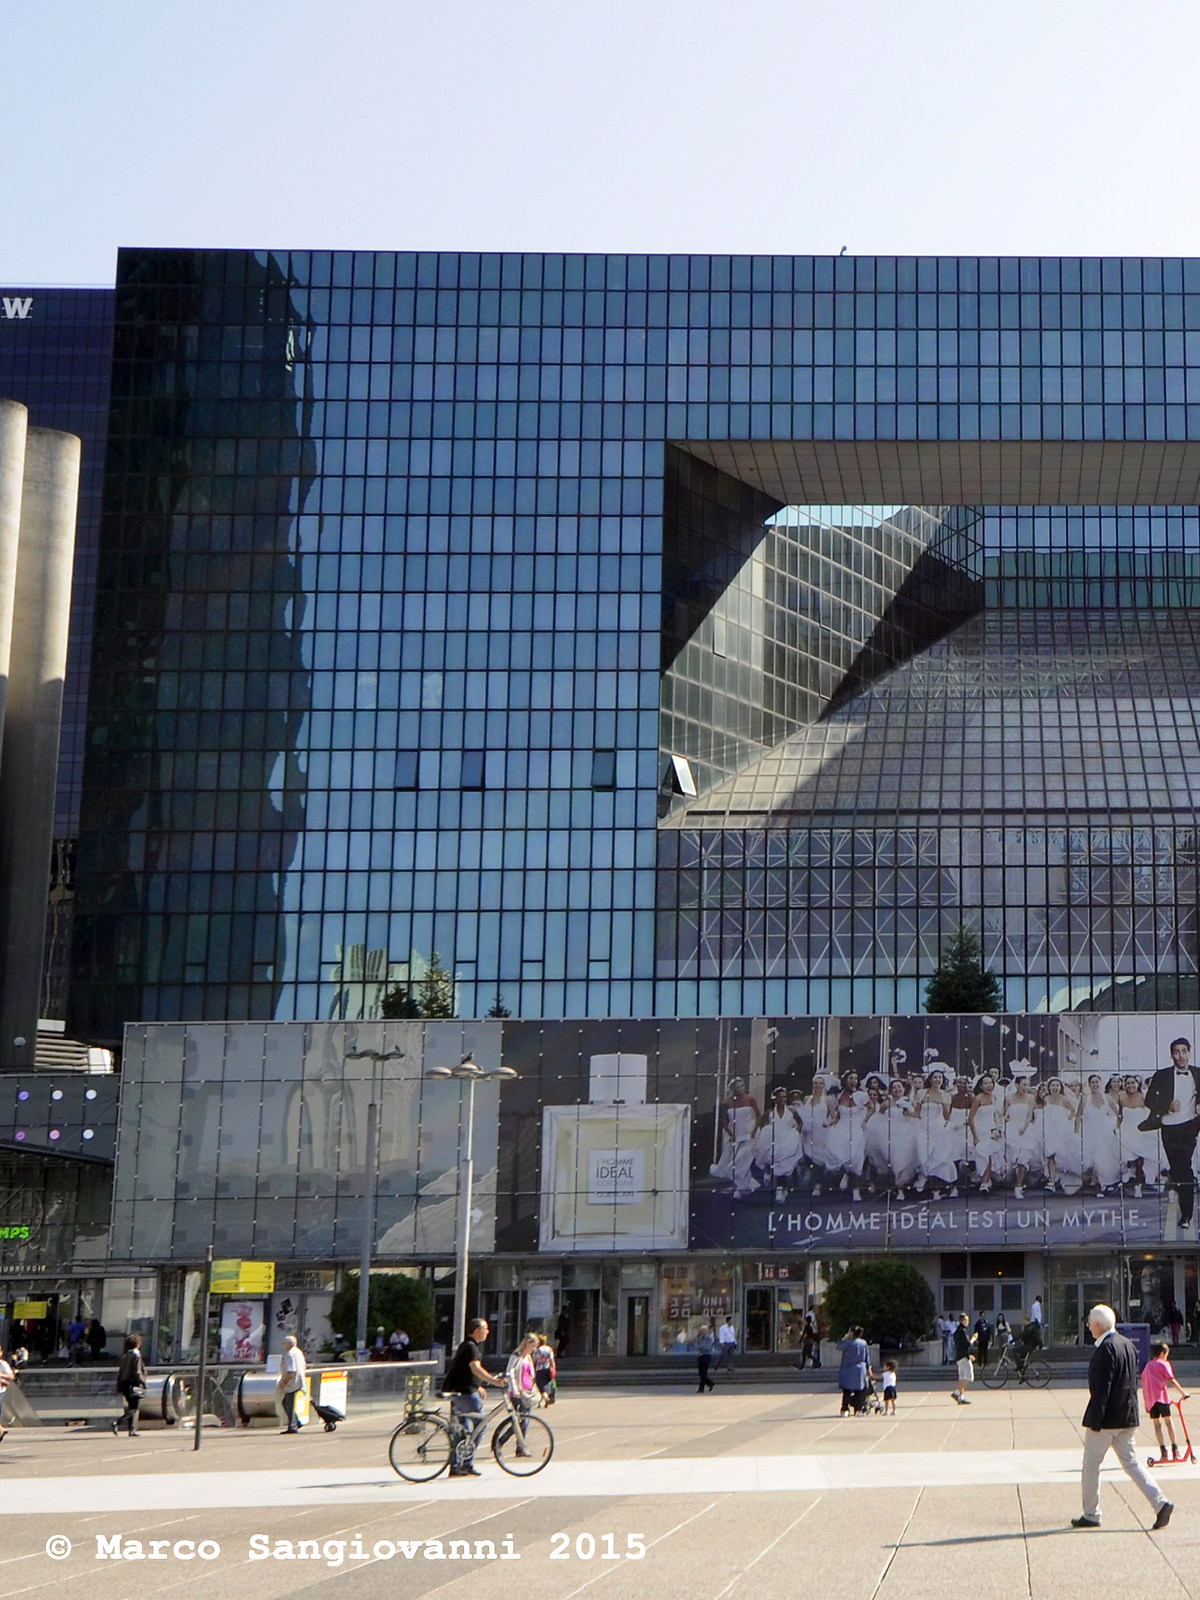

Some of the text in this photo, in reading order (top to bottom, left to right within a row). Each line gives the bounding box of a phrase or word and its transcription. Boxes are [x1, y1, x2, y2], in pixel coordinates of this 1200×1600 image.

[767, 1211, 881, 1232] L'HOMME
[890, 1207, 958, 1230] IDÉAL
[967, 1210, 1007, 1230] EST
[1016, 1210, 1051, 1228] UN
[1061, 1209, 1148, 1228] MYTHE.
[703, 1296, 723, 1307] UNI
